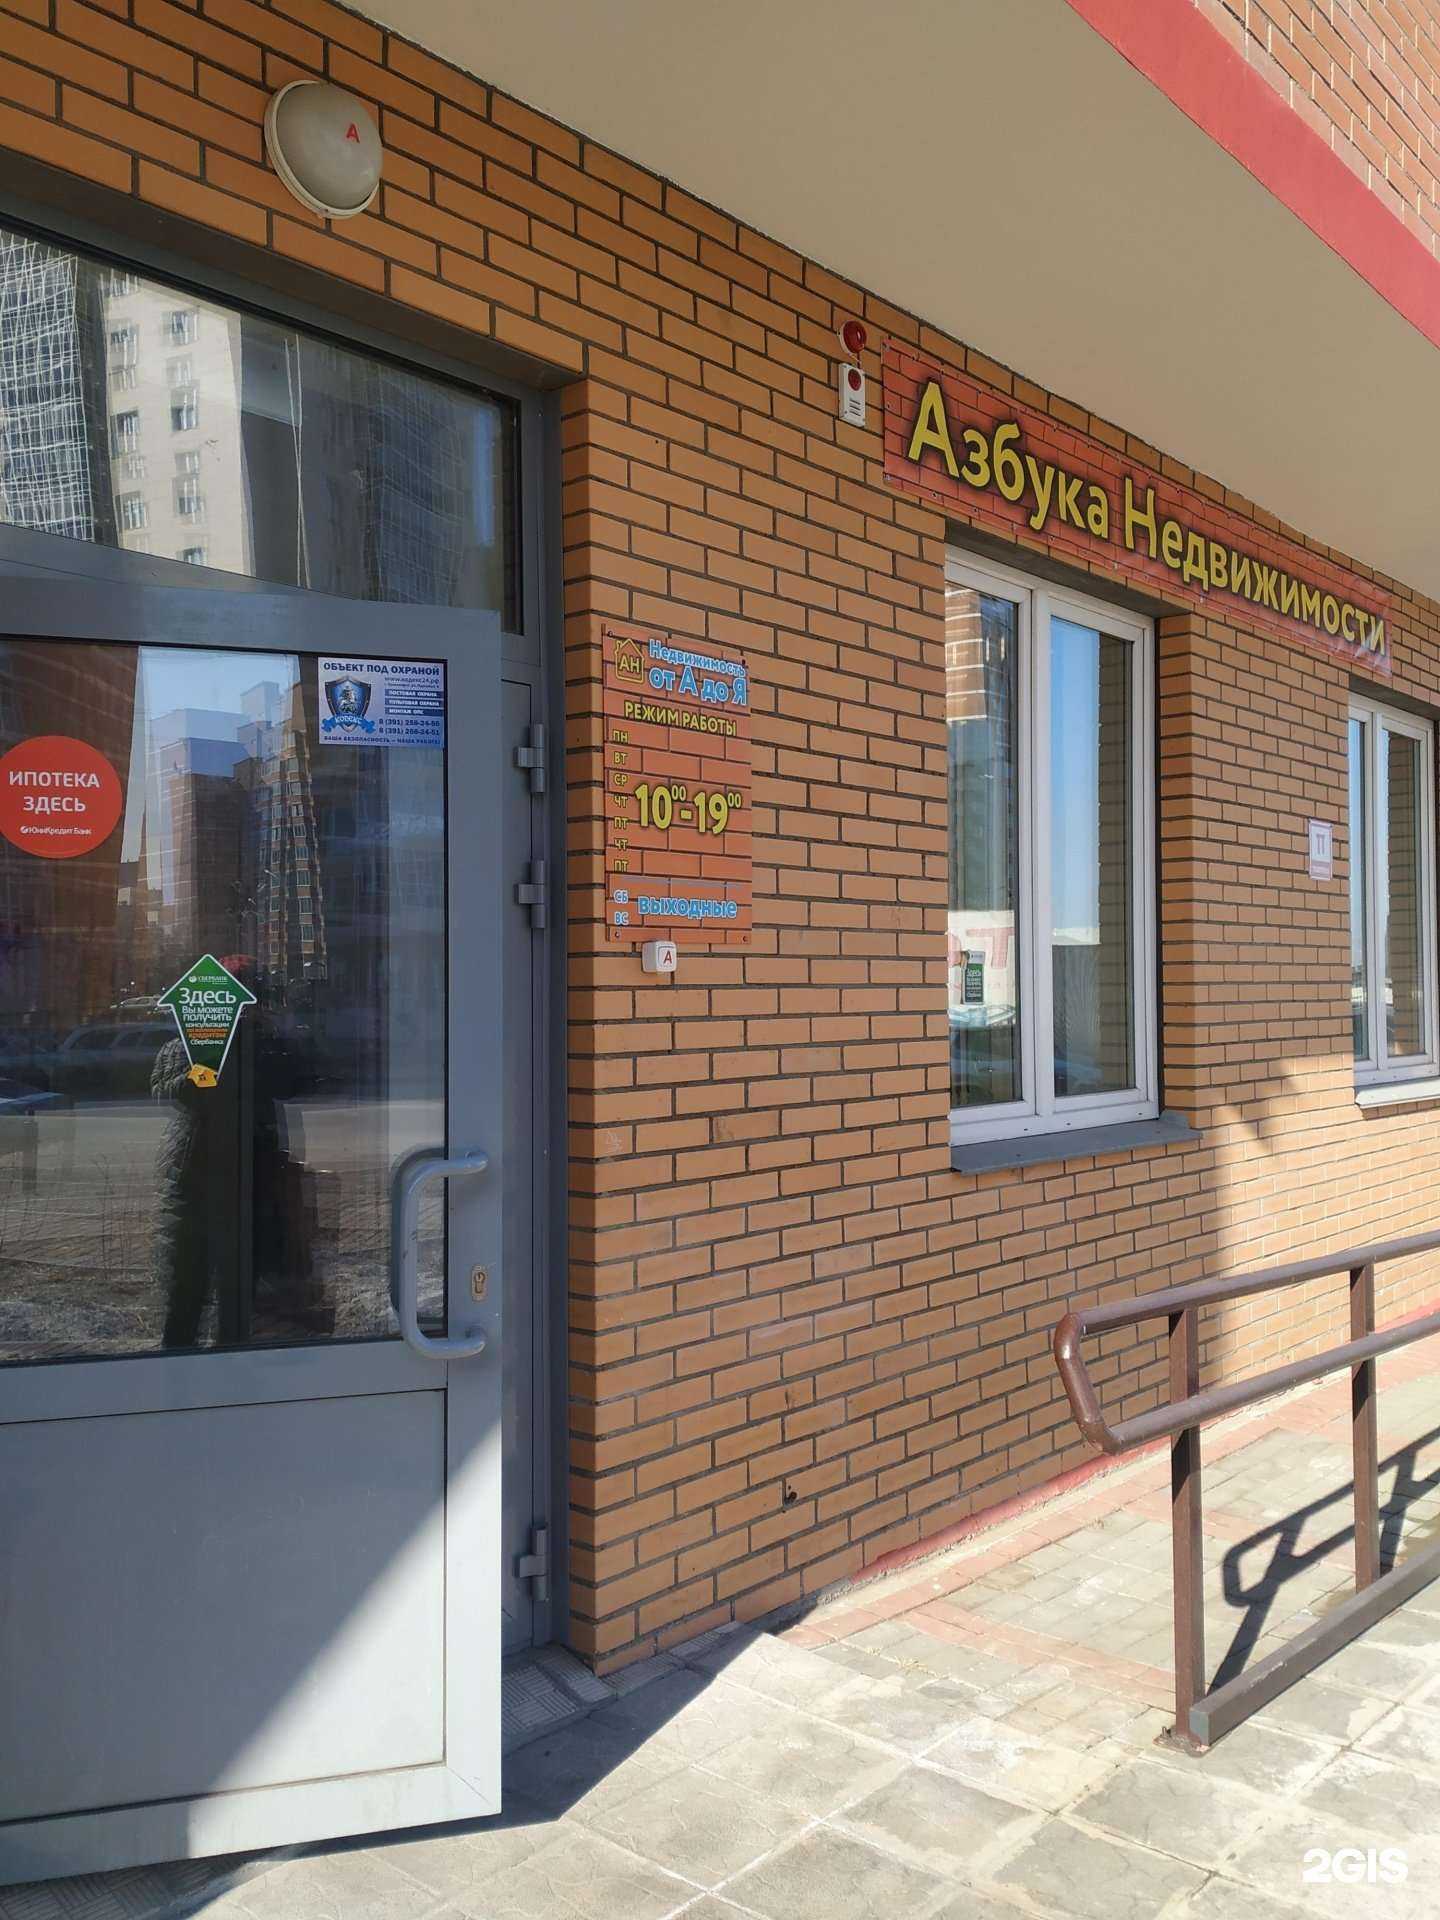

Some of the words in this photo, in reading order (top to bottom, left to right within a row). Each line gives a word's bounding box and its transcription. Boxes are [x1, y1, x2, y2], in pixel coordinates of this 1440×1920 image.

[907, 381, 1109, 539] Азбука
[1123, 477, 1386, 657] Недвижимости
[648, 638, 746, 678] Недвижимость
[323, 662, 365, 673] ОБЪЕКТ
[366, 664, 389, 675] ПОД
[390, 665, 440, 676] ОХРАНОЙ
[618, 657, 641, 675] АН
[648, 667, 676, 692] от
[678, 665, 699, 697] А
[701, 678, 729, 704] до
[731, 677, 747, 706] Я
[623, 701, 679, 727] РЕЖИМ
[682, 712, 737, 737] РАБОТЫ
[612, 730, 629, 744] ПН
[613, 751, 627, 765] ВТ
[8, 770, 101, 789] ИПОТЕКА
[613, 773, 628, 786] СР
[22, 795, 87, 815] ЗДЕСЬ
[613, 795, 628, 809] ЧТ
[613, 817, 628, 830] ПТ
[613, 838, 628, 852] ЧТ
[613, 860, 629, 873] ПТ
[178, 987, 237, 1007] Здесь
[182, 1005, 197, 1014] Вы
[198, 1006, 233, 1014] можете
[182, 1013, 233, 1023] получить
